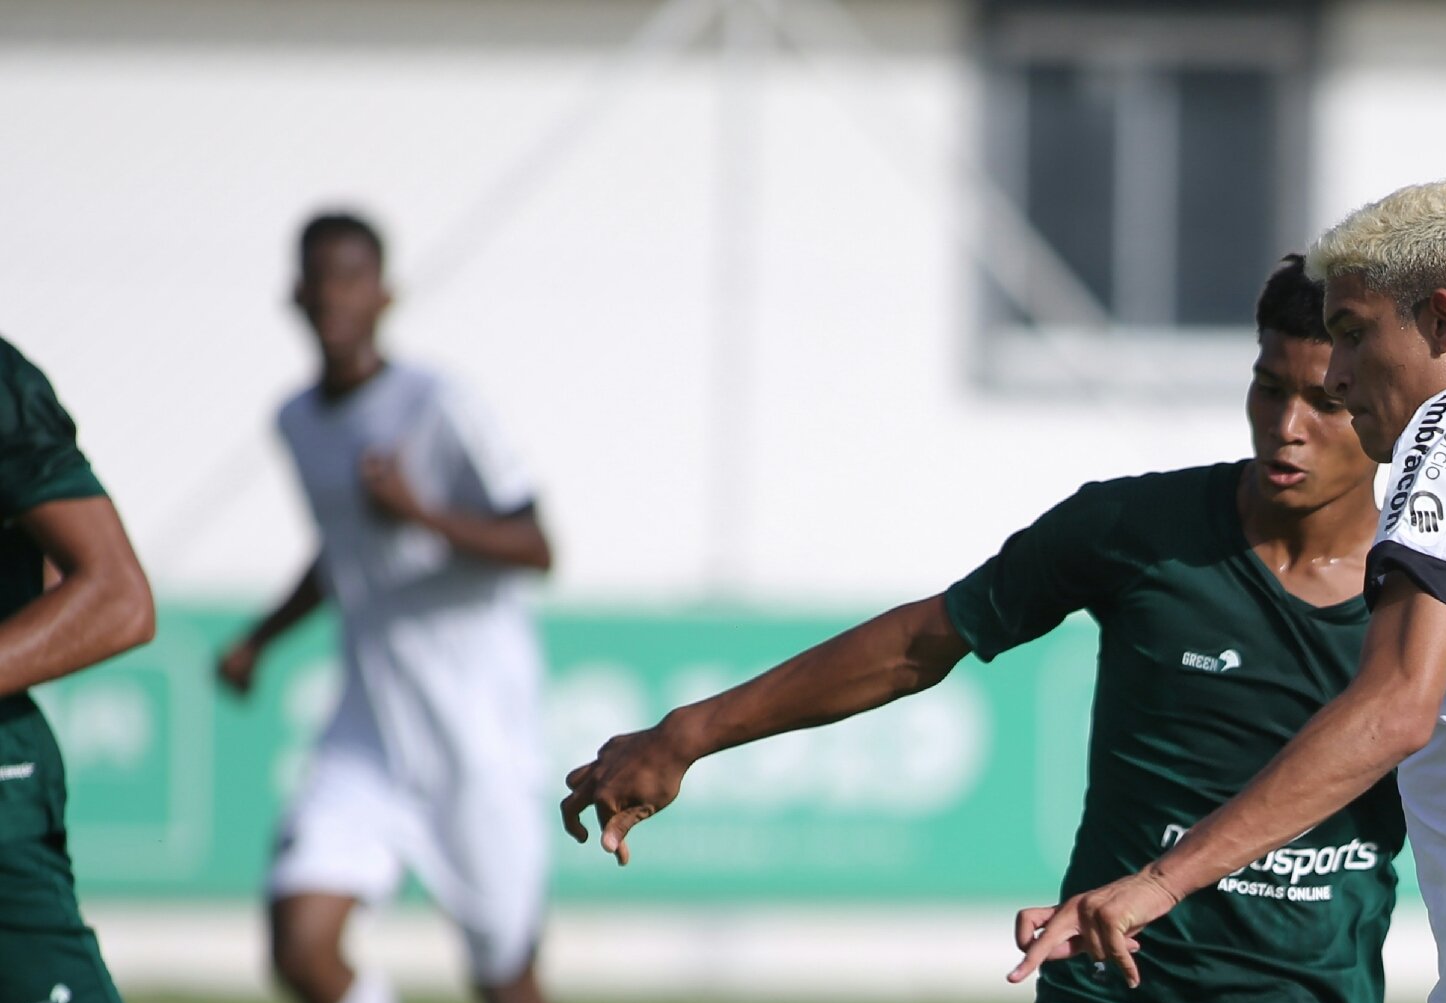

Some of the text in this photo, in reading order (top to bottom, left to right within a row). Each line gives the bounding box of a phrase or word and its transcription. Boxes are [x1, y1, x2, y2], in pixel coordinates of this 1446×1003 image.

[1181, 651, 1219, 672] GREEN
[1217, 878, 1333, 902] APOSTAS ONLINE
